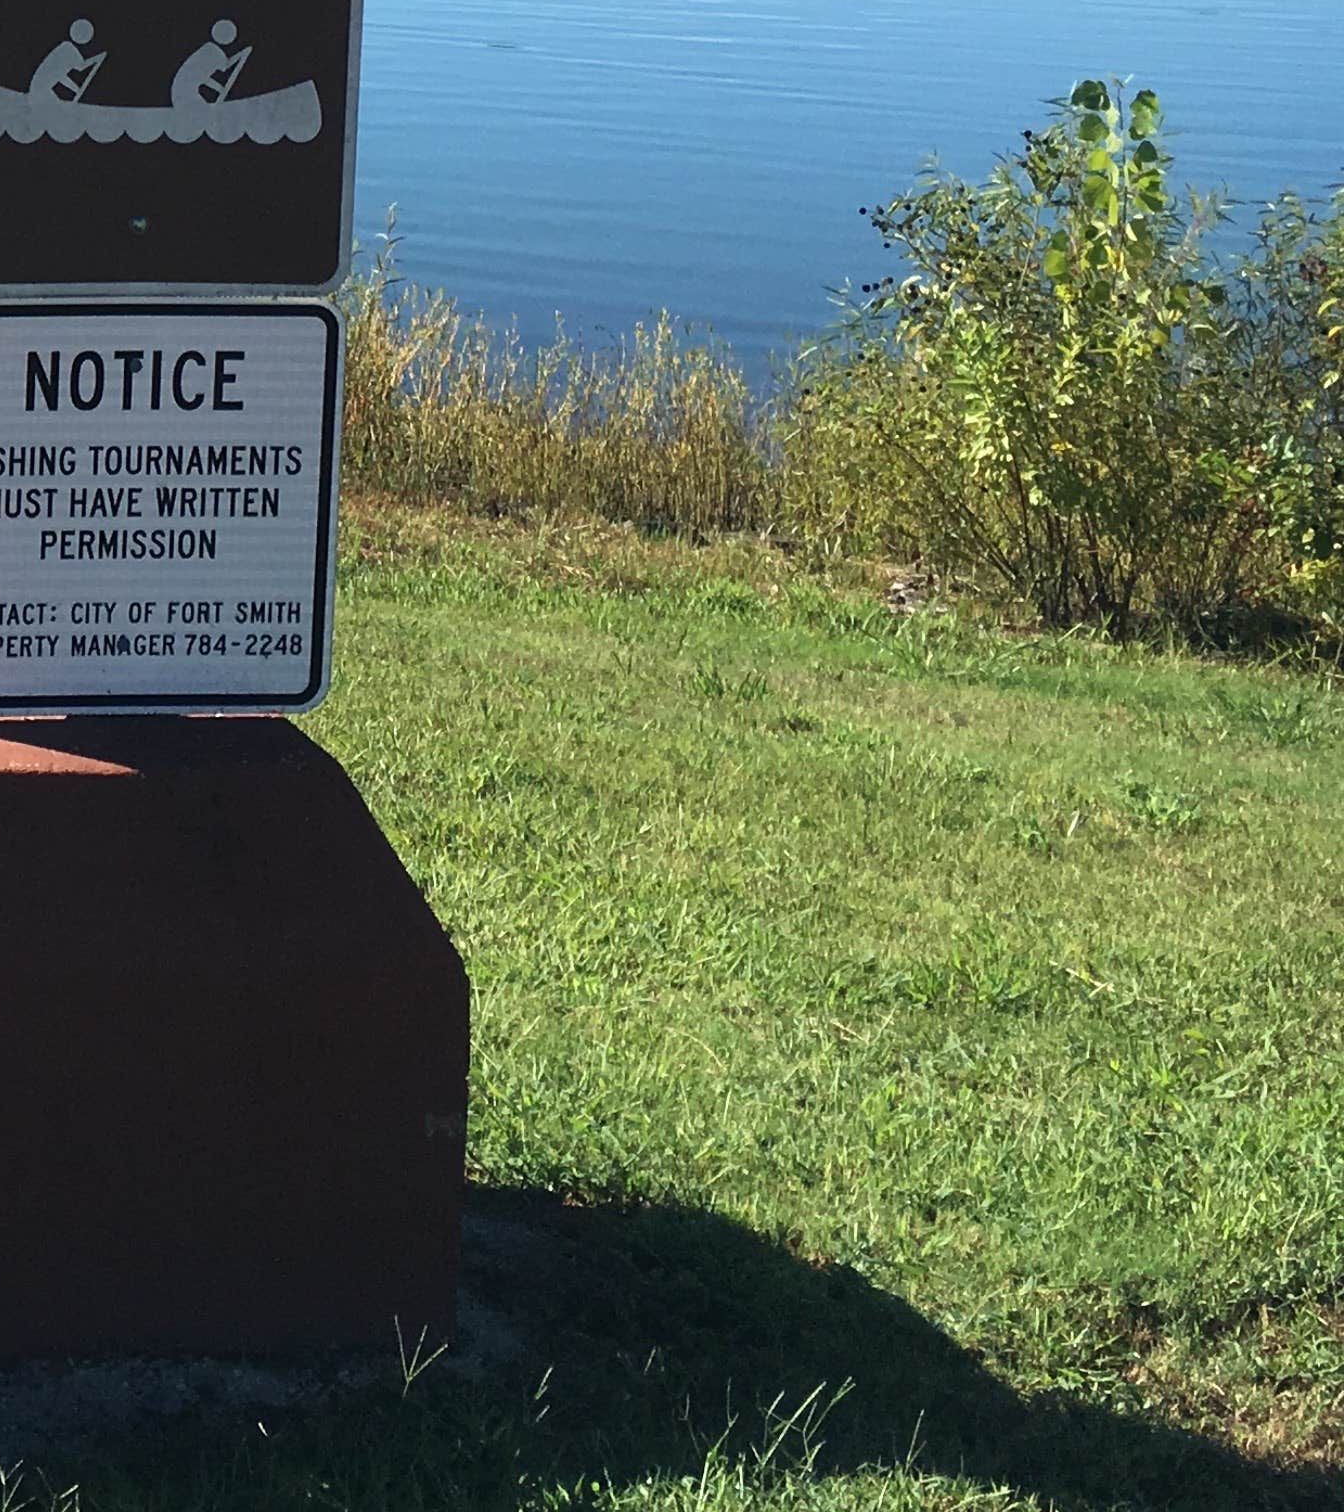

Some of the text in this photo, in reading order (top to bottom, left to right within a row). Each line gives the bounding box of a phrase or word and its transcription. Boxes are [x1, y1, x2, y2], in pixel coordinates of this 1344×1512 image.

[25, 350, 245, 411] NOTICE
[89, 445, 302, 475] TOURNAMENTS
[70, 488, 143, 518] HAVE
[156, 486, 279, 517] WRITTEN
[40, 529, 216, 560] PERMISSION
[71, 602, 117, 624] CITY
[129, 602, 156, 624] OF
[167, 601, 224, 624] FORT
[235, 601, 301, 624] SMITH
[184, 633, 302, 659] 784-2248
